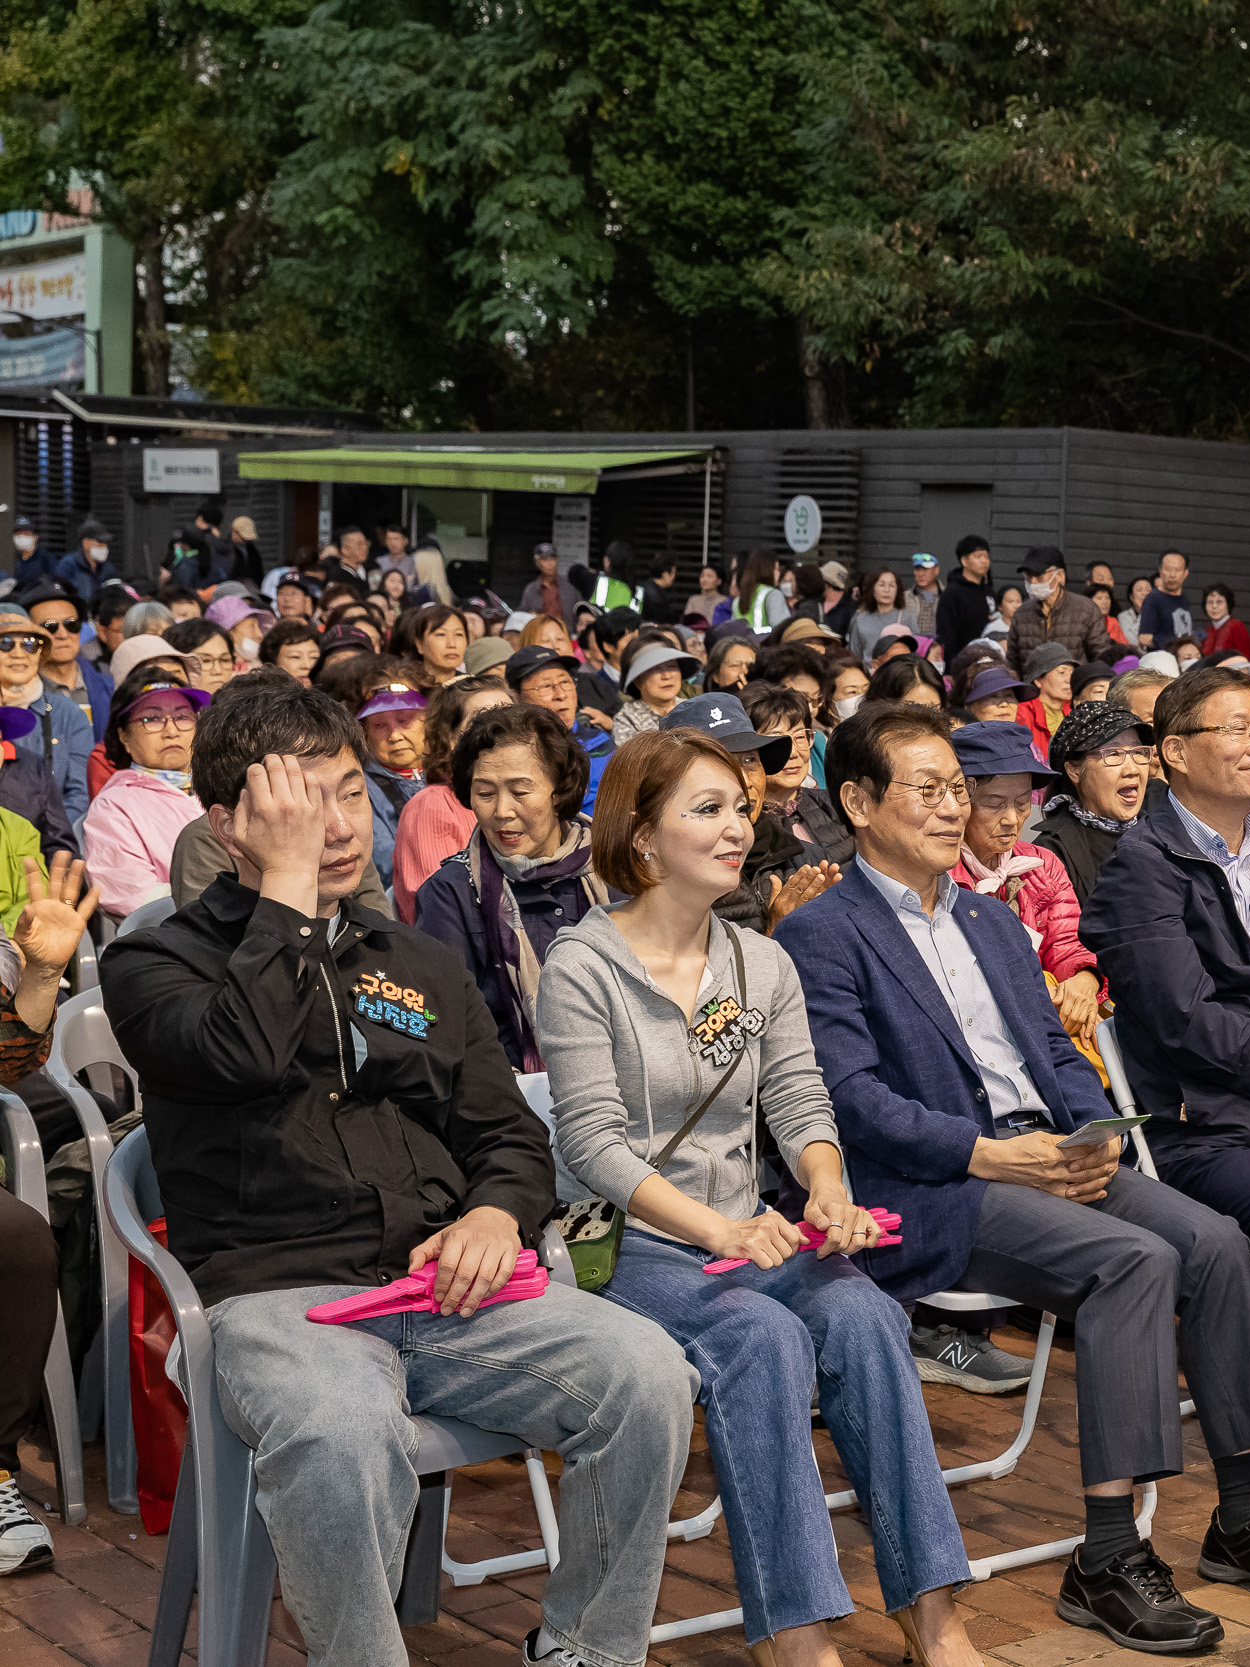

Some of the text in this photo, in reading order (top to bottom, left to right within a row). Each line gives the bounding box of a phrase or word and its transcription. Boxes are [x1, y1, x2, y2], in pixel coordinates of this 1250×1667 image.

[361, 973, 425, 1013] 구의원
[357, 994, 429, 1038] 신진호
[694, 997, 742, 1043] 구의원
